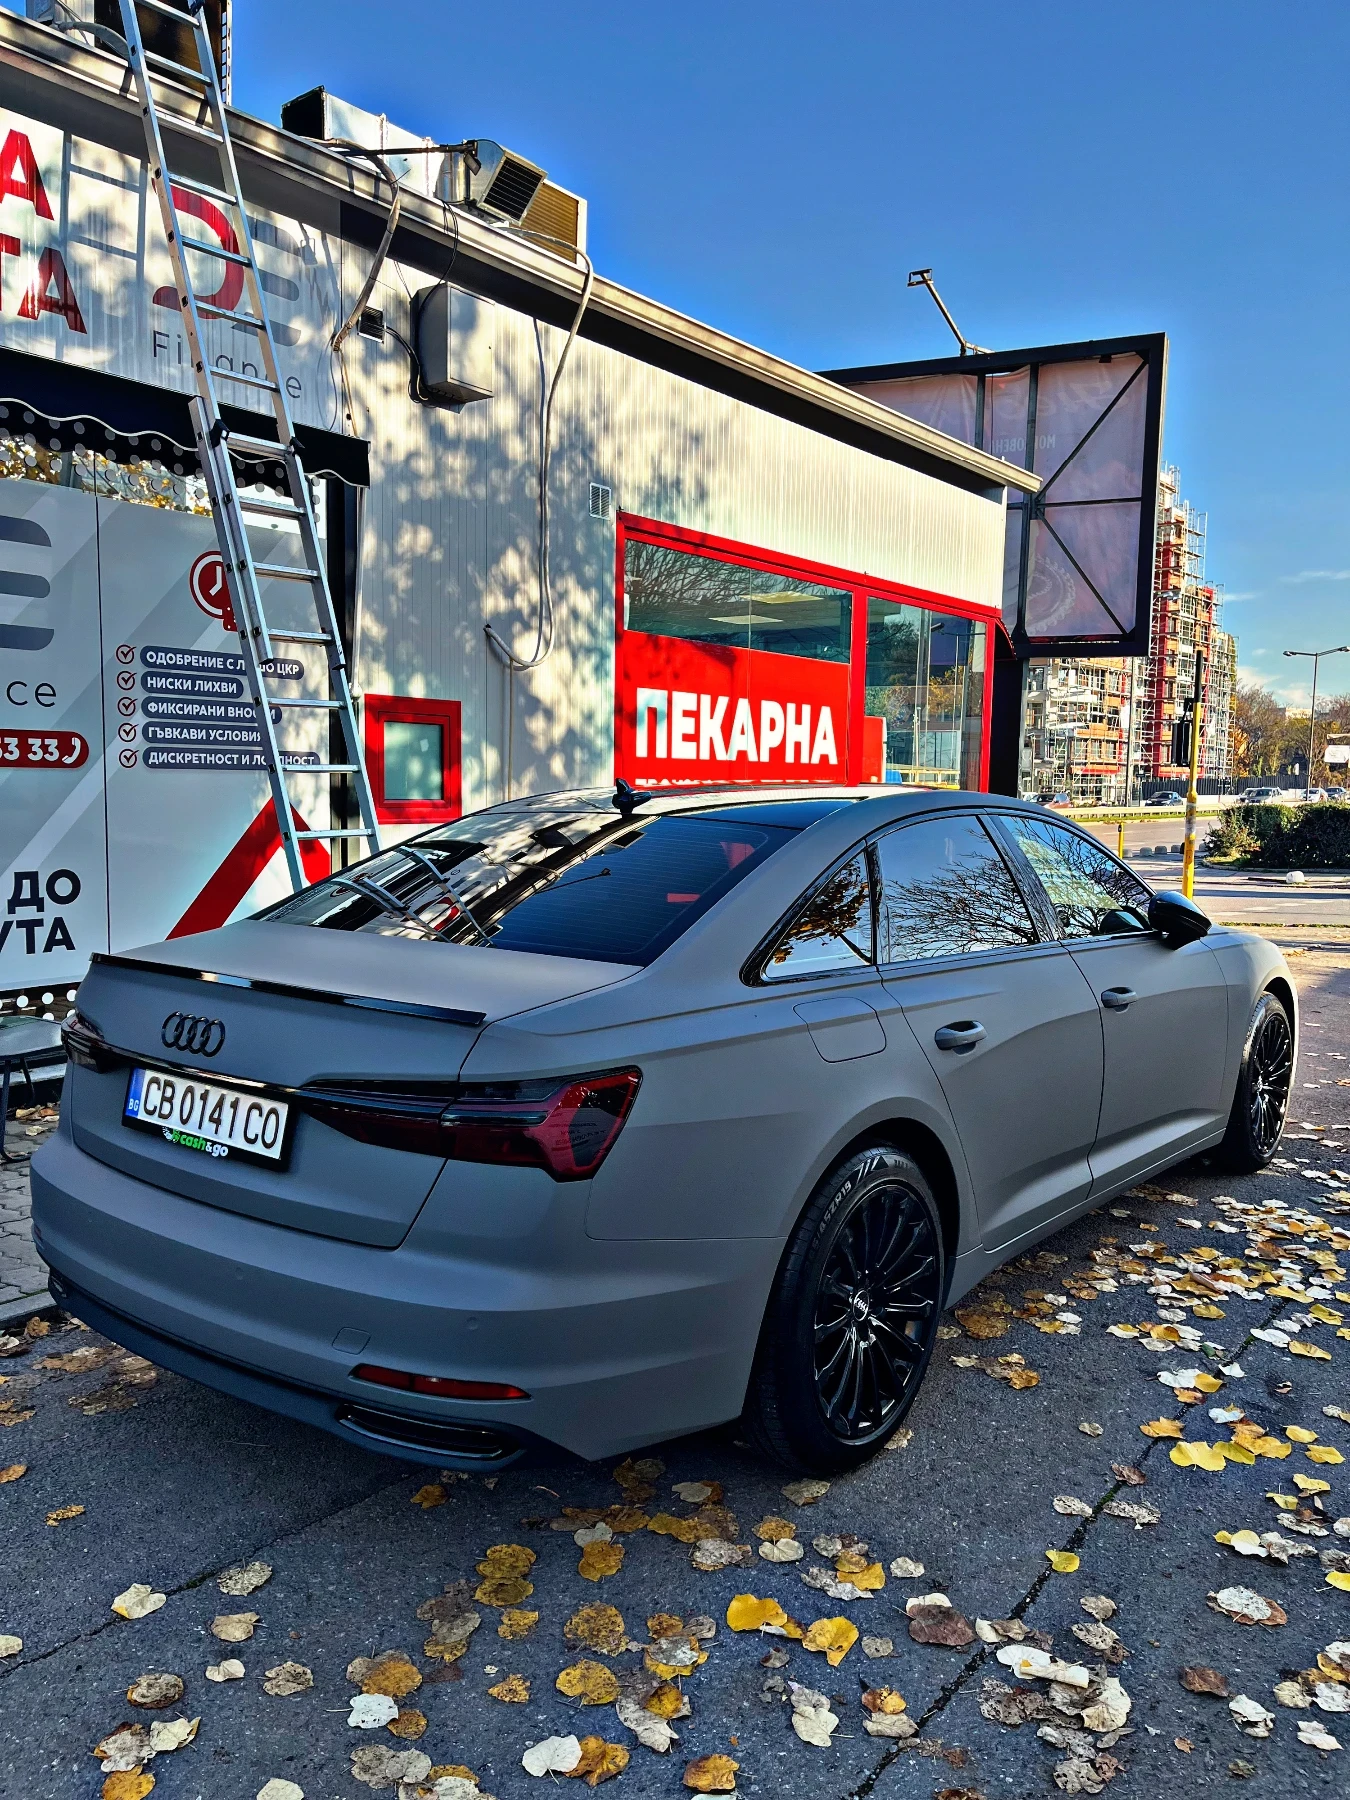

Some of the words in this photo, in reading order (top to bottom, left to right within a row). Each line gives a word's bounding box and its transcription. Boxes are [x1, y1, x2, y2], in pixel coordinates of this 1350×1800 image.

[153, 330, 302, 399] Fiane
[146, 650, 225, 670] ОДОБРЕНИЕ
[226, 658, 235, 670] С
[236, 659, 275, 673] ЛО
[277, 663, 300, 676] ЦКР
[147, 676, 192, 691] НИСКИ
[194, 680, 237, 694] ЛИХВИ
[147, 701, 225, 717] ФИКСИРАНИ
[227, 706, 276, 720] ВНОИ
[148, 726, 206, 741] ГЪВКАВИ
[635, 687, 839, 765] ПЕКАРНА
[0, 737, 20, 761] 3
[27, 738, 60, 761] 33
[148, 751, 239, 766] ДИСКРЕТНОСТ
[241, 754, 250, 765] И
[7, 868, 82, 914] ДО
[128, 1098, 139, 1111] BG
